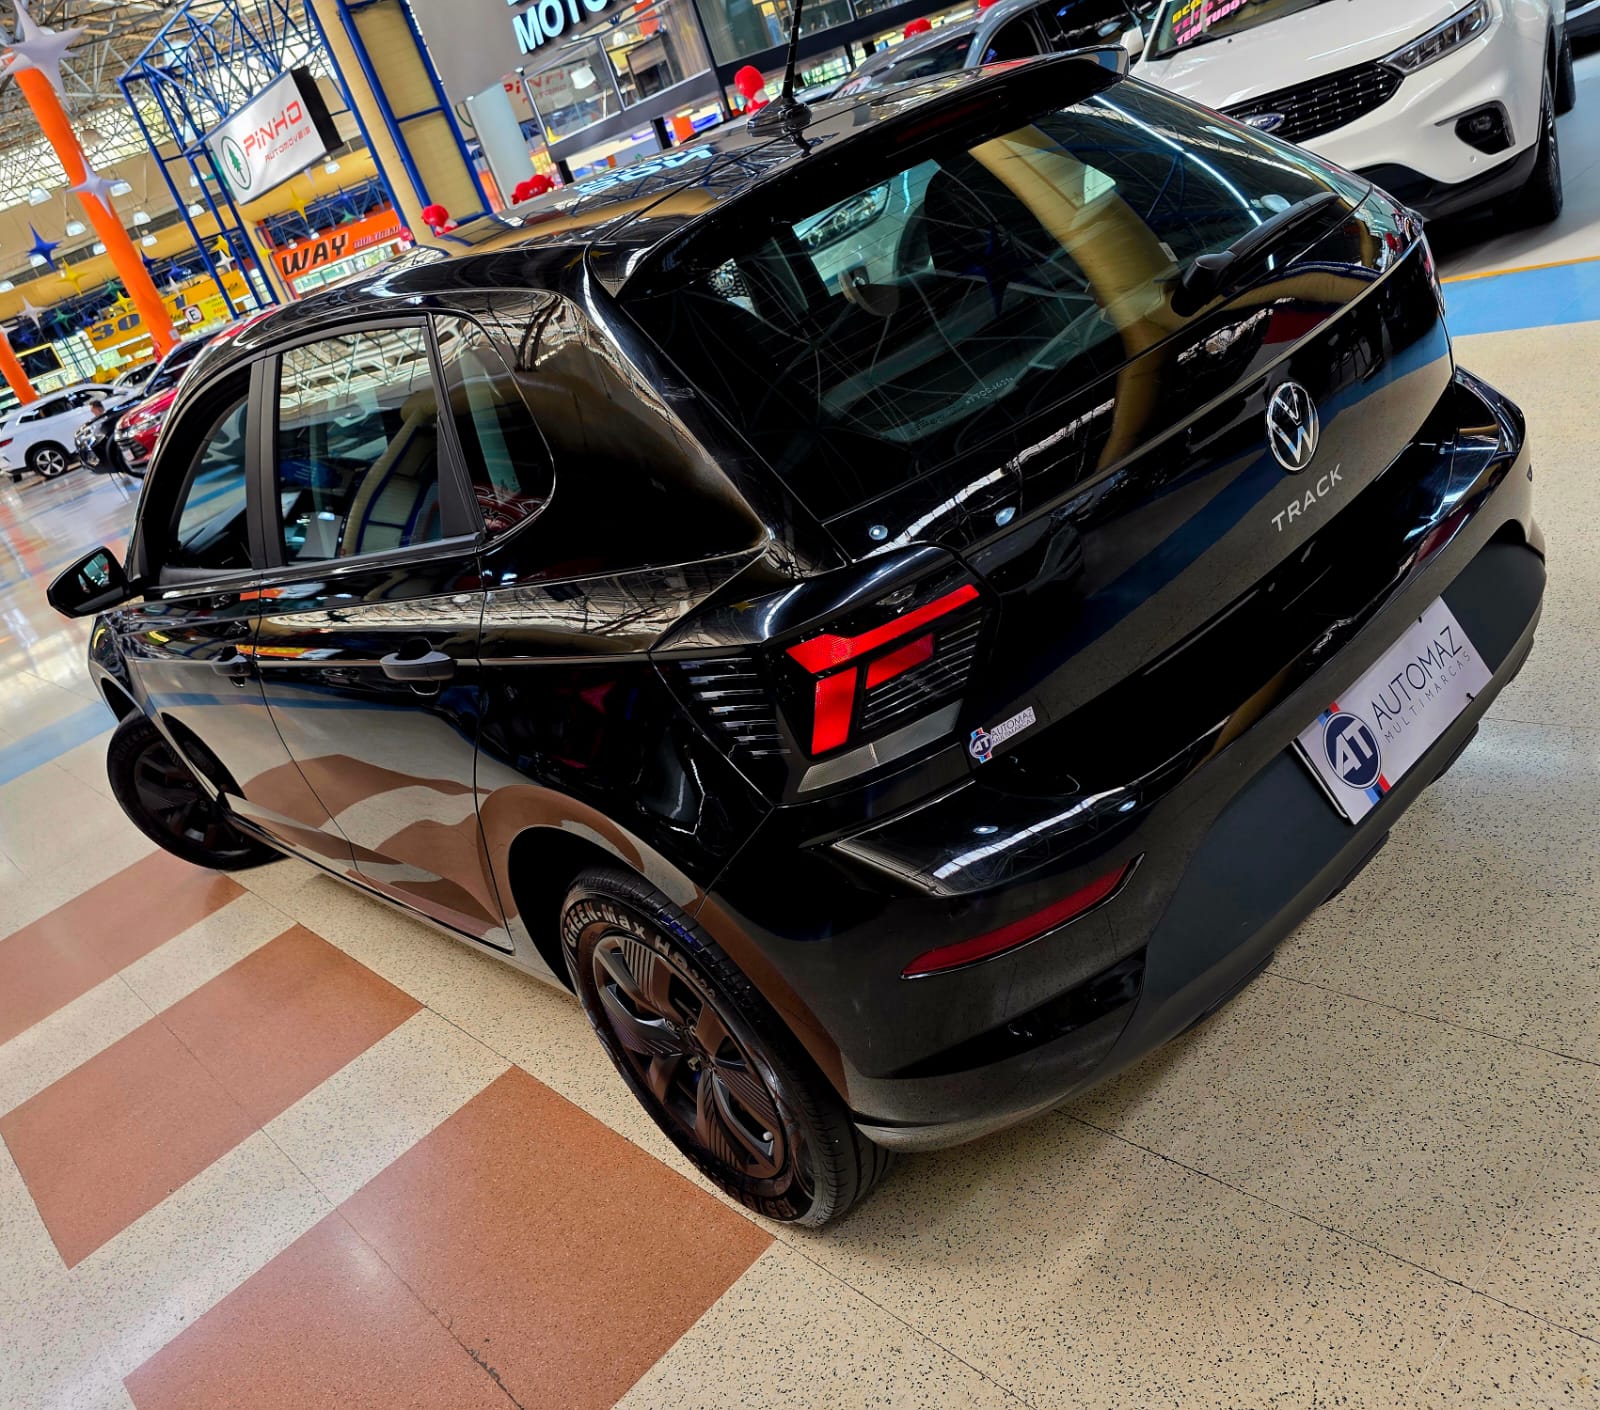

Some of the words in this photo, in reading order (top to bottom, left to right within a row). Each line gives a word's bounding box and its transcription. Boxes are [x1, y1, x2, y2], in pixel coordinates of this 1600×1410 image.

[1176, 21, 1203, 45] TEM
[282, 232, 348, 276] WAY
[1271, 463, 1343, 532] TRACK
[1371, 625, 1462, 730] AUTOMAZ
[1384, 651, 1471, 743] MULTIMARCAS
[1335, 718, 1373, 778] AT
